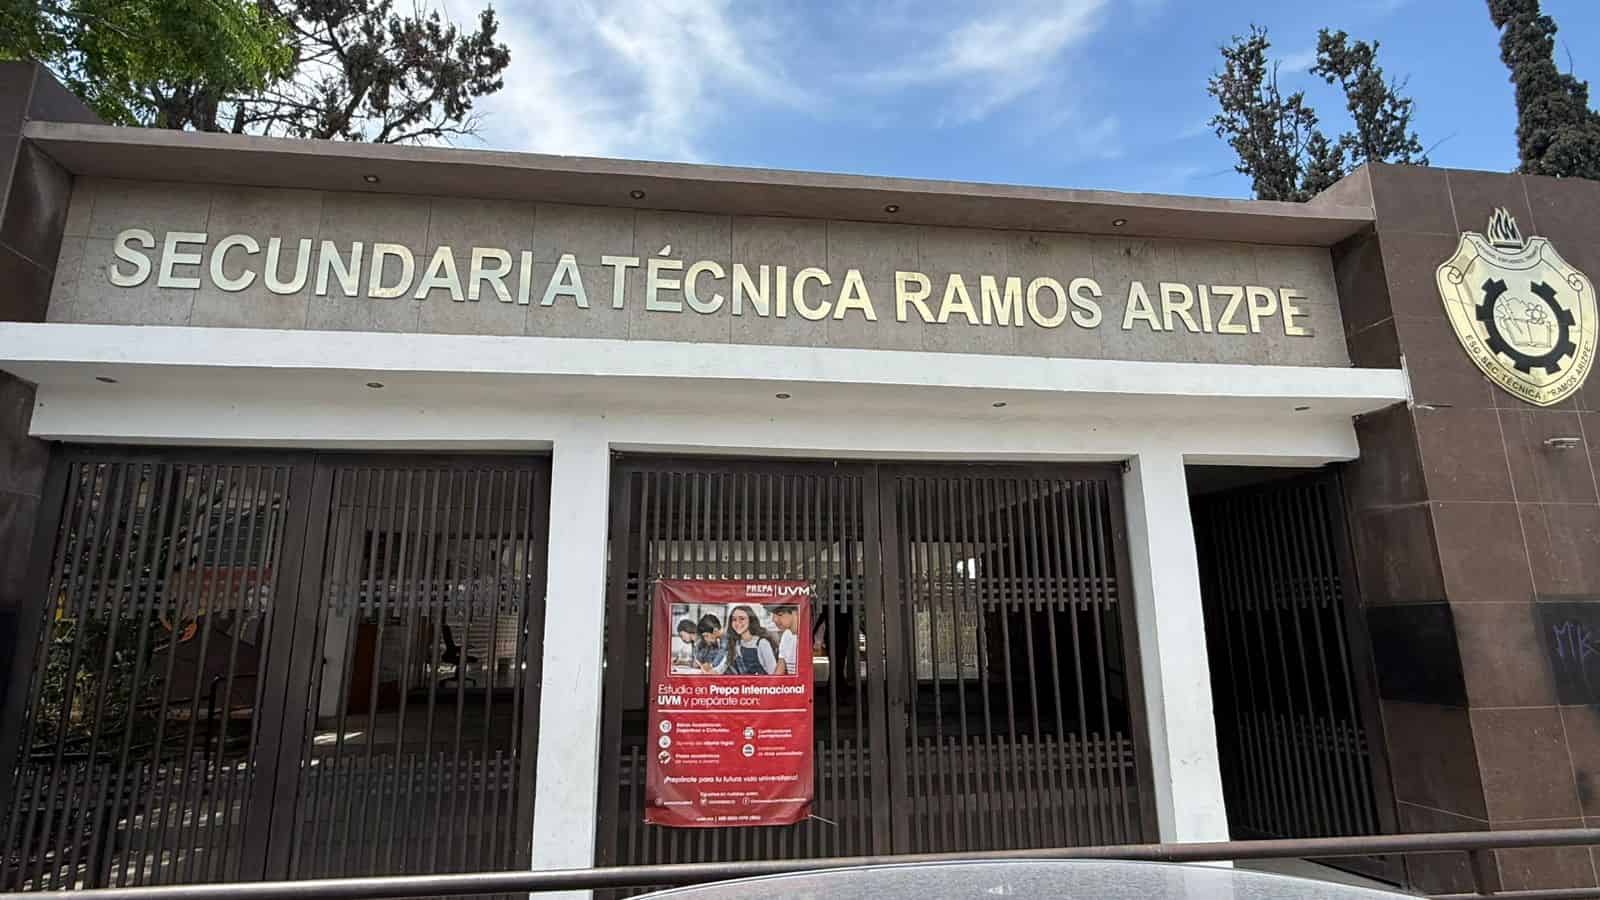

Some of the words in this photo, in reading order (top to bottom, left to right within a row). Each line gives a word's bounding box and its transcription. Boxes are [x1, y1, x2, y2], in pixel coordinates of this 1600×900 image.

[109, 228, 590, 309] SECUNDARIA
[601, 245, 878, 322] TÉCNICA
[895, 270, 1103, 329] RAMOS
[1122, 281, 1315, 337] ARIZPE
[746, 584, 772, 593] PREPA
[778, 586, 810, 596] UVM
[658, 684, 694, 695] Estudia
[695, 687, 708, 695] en
[709, 685, 740, 697] Prepa
[741, 684, 805, 695] Internacional
[658, 695, 681, 705] UVM
[683, 697, 689, 707] y
[690, 695, 738, 707] prepárate
[739, 697, 760, 705] con:
